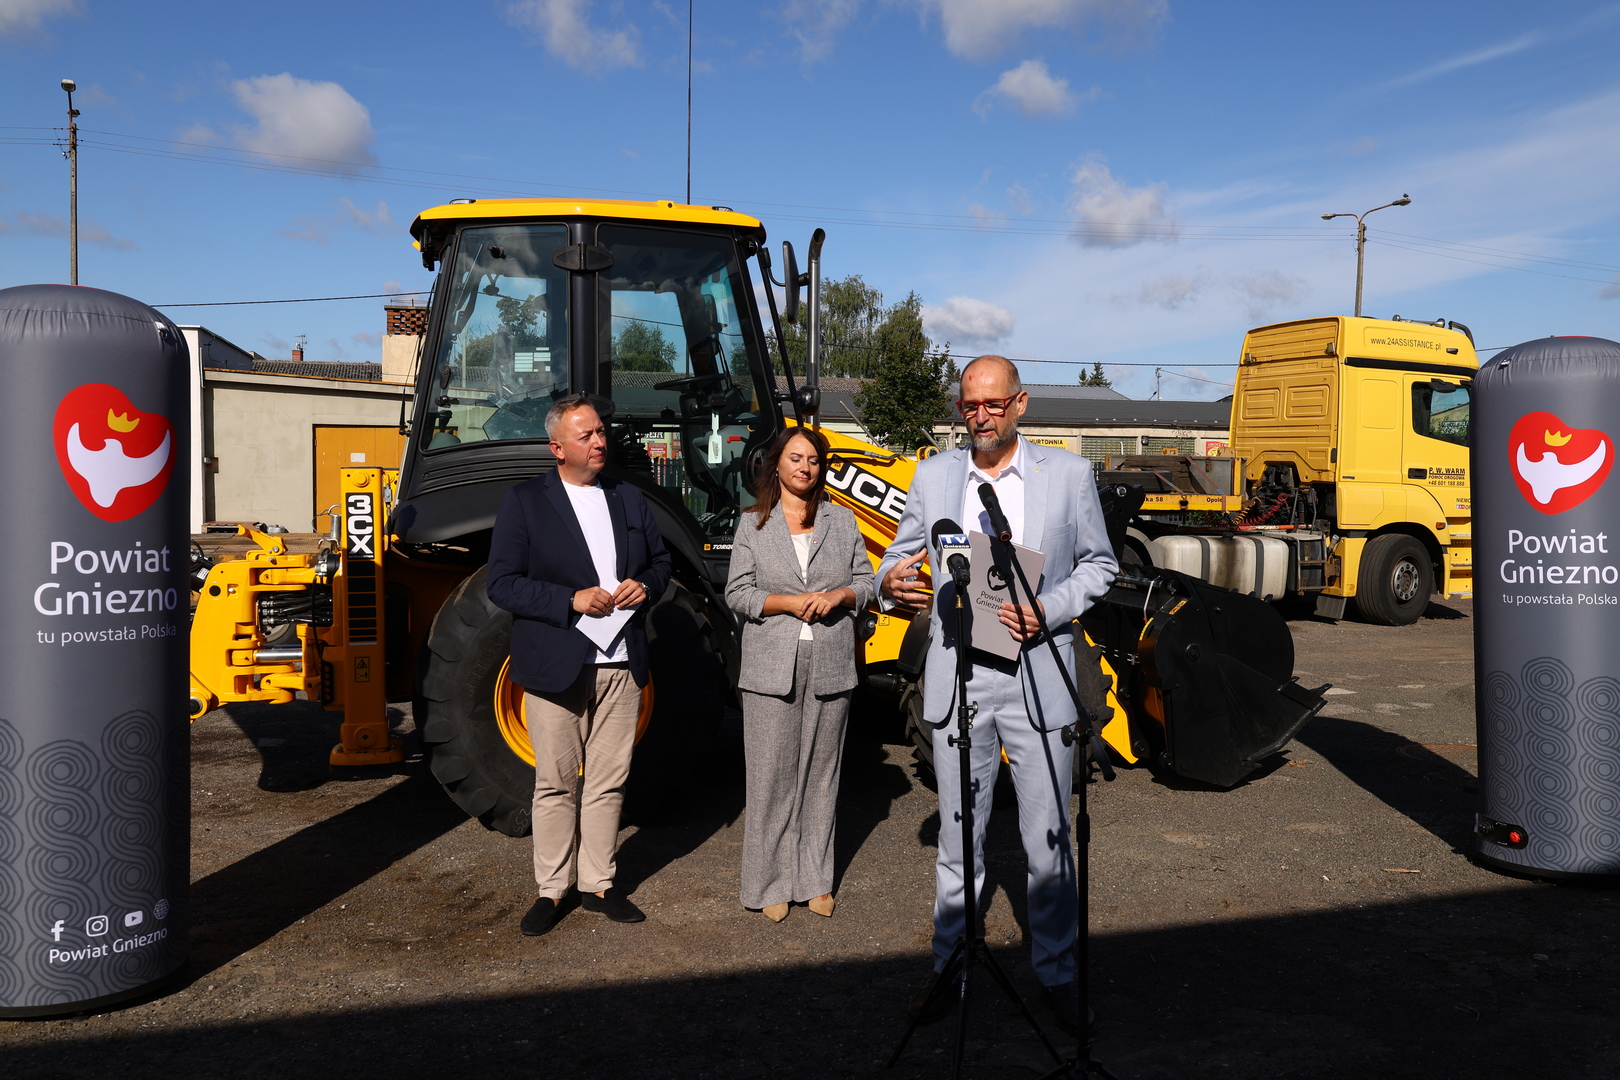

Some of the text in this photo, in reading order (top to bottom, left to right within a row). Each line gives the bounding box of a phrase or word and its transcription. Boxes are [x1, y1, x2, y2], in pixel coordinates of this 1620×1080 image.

[1370, 337, 1441, 351] www.24ASSISTANCE.pl
[347, 495, 374, 554] 3CX
[1508, 528, 1609, 554] Powiat
[50, 541, 171, 574] Powiat
[1500, 559, 1619, 584] Gniezno
[34, 582, 178, 616] Gniezno
[976, 597, 1003, 610] Gniezn
[980, 590, 1004, 604] Powiat
[1502, 593, 1618, 606] tu powstała Polska
[36, 623, 176, 647] tu powstała Polska
[49, 928, 168, 964] Powiat Gniezno
